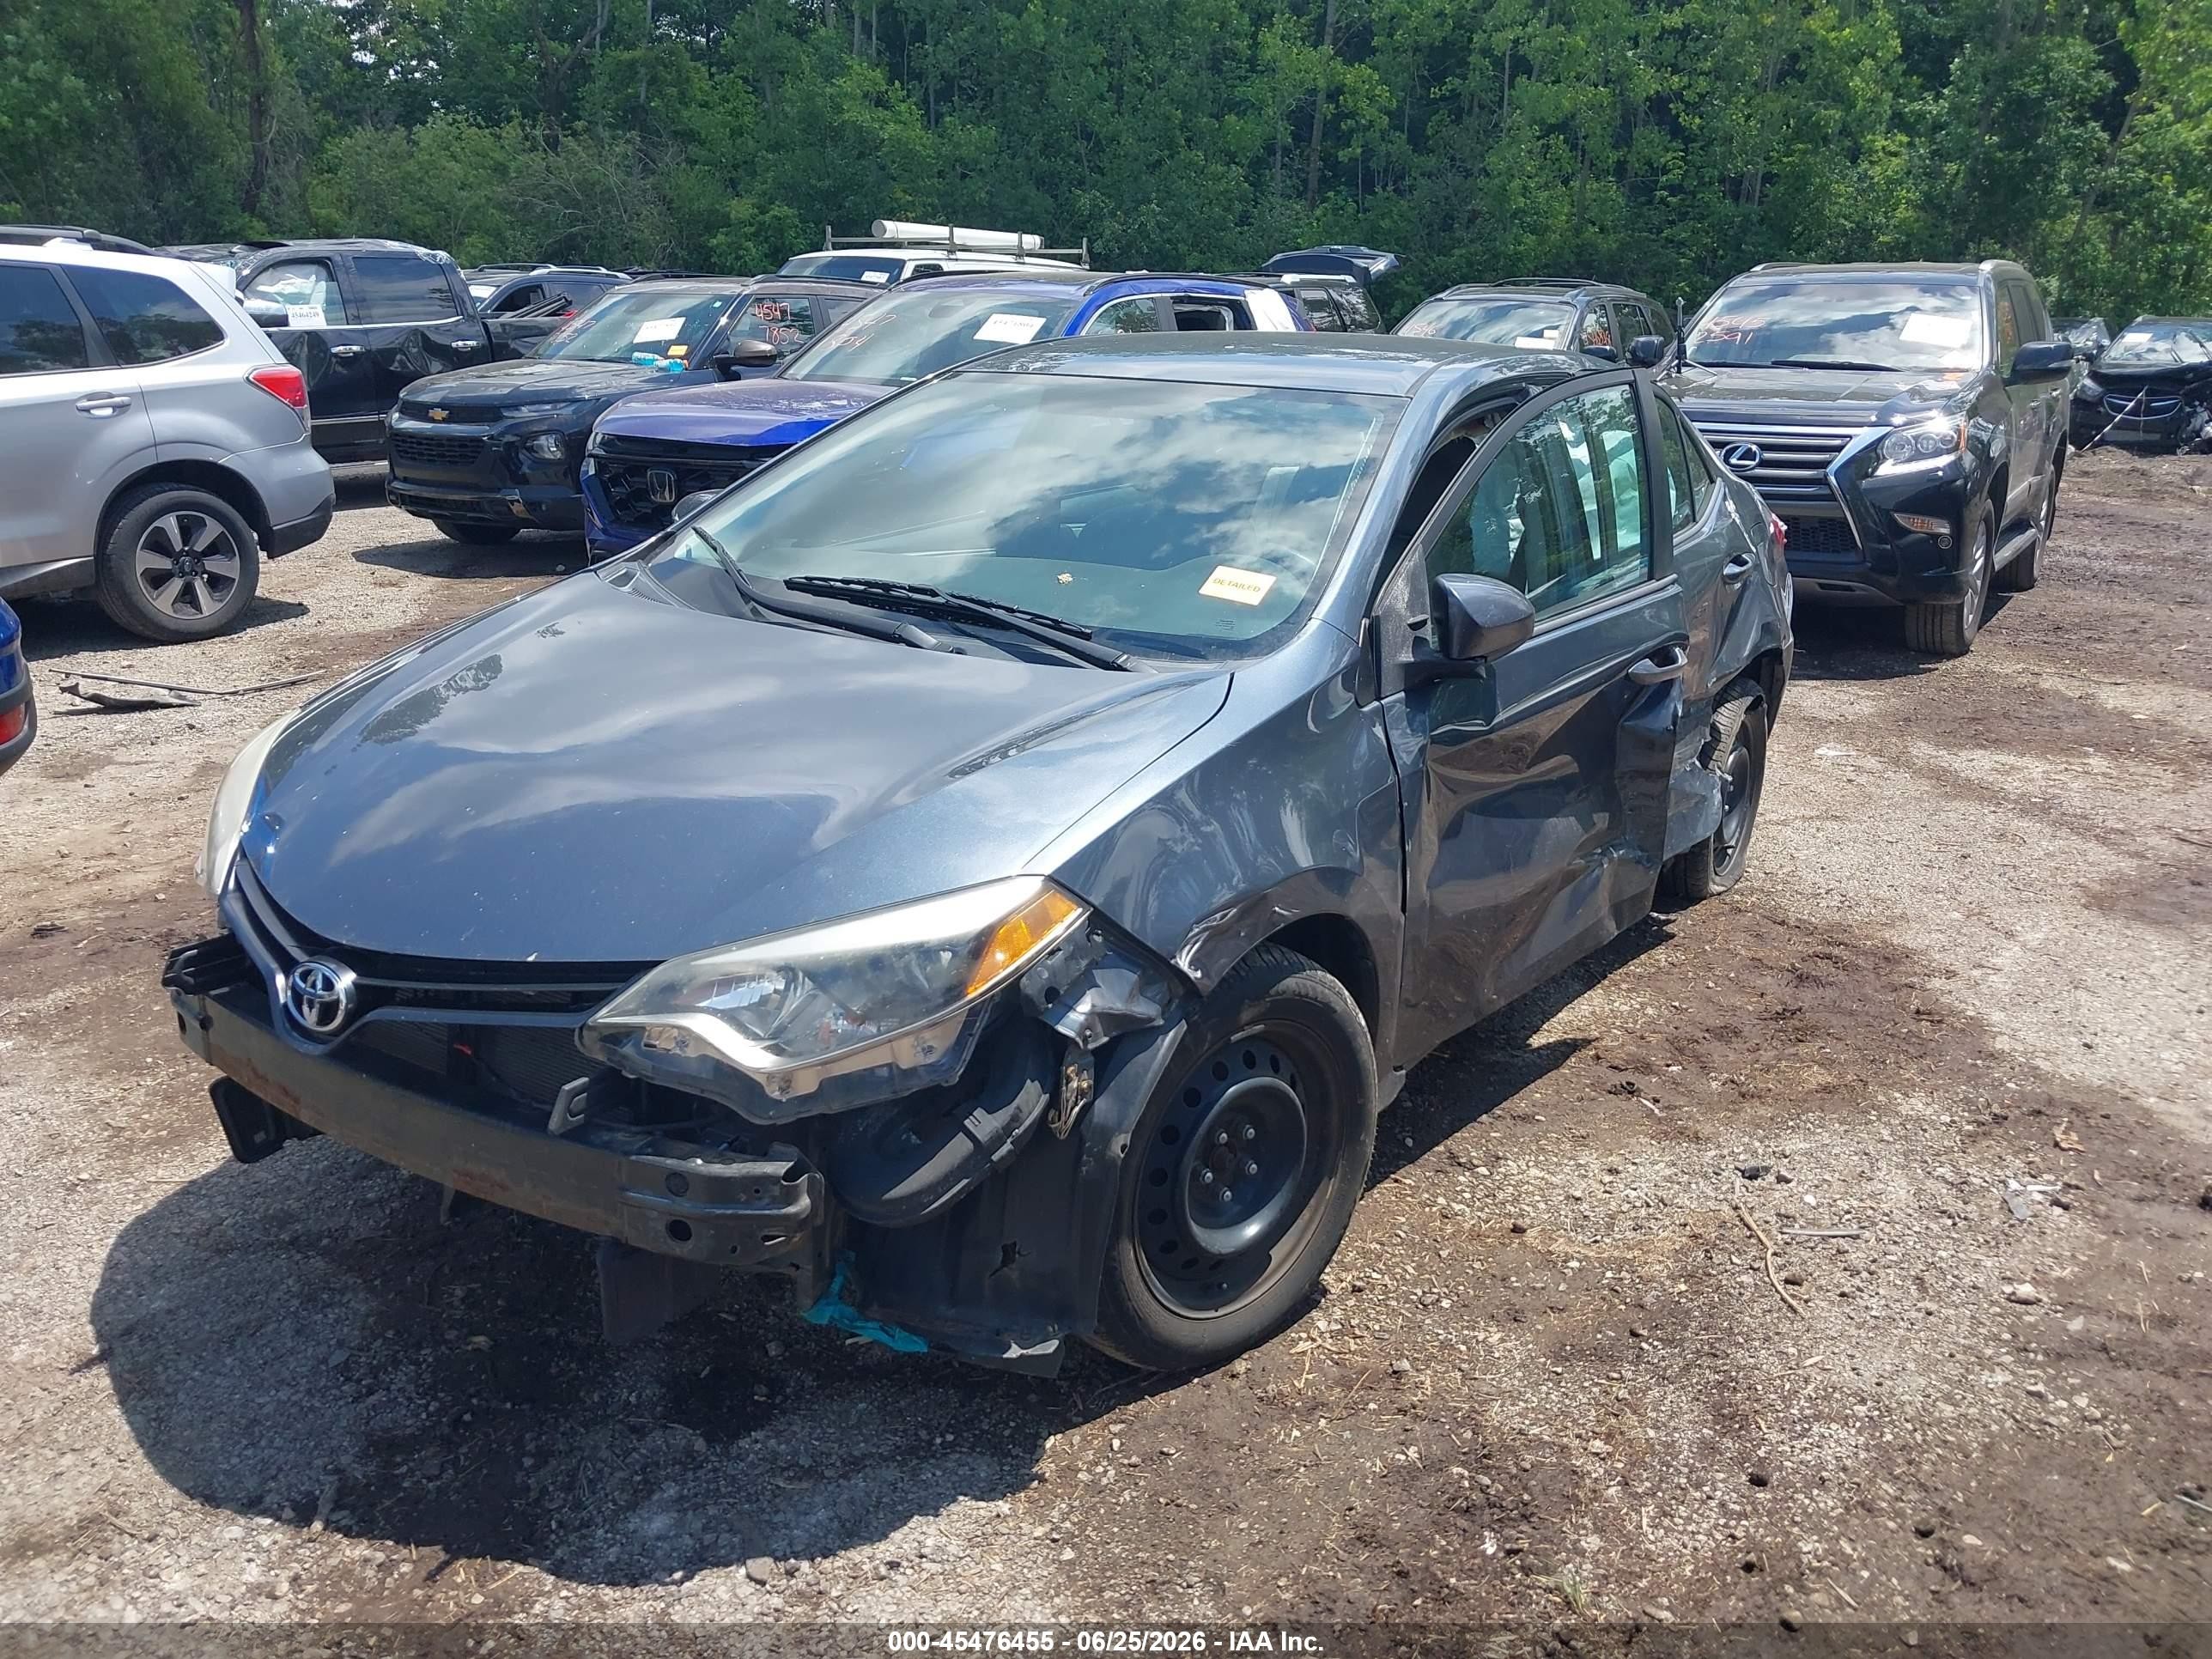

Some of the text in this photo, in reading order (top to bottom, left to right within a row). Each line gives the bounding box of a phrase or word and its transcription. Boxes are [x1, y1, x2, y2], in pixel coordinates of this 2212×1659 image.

[754, 301, 791, 321] 4547
[758, 323, 805, 345] 7852
[1693, 331, 1753, 345] 2591
[1212, 577, 1261, 592] DETAILED
